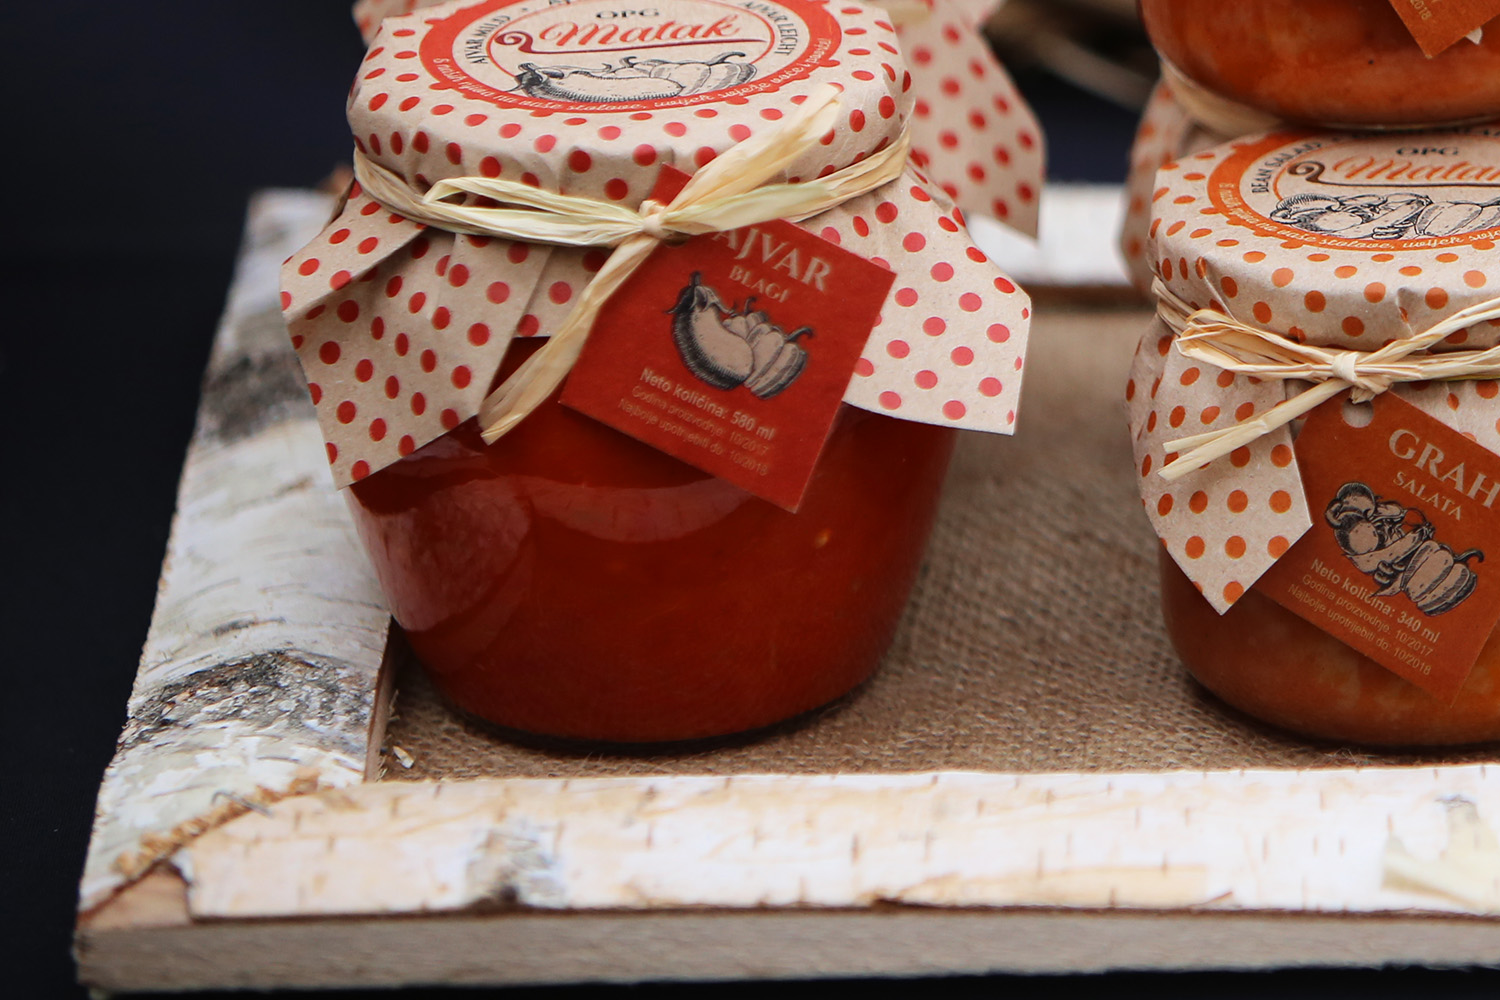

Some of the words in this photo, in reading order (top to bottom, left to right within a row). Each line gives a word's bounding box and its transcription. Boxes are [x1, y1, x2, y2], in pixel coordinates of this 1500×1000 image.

[538, 14, 742, 47] Matak
[596, 9, 660, 19] OPG
[464, 38, 489, 64] AJVAR
[774, 22, 798, 56] LEICHT
[1251, 168, 1273, 194] BEAN
[712, 225, 833, 292] AJVAR
[728, 264, 792, 304] BLAGI
[618, 398, 659, 425] Najbolje
[632, 385, 667, 410] Godina
[640, 368, 671, 392] Neto
[672, 383, 727, 419] količina:
[730, 410, 755, 432] 580
[756, 423, 776, 441] ml
[1393, 471, 1462, 521] SALATA
[1302, 574, 1335, 600] Godina
[1395, 629, 1434, 657] 10/2017
[1311, 558, 1341, 584] Neto
[1397, 611, 1421, 632] 340
[1421, 627, 1441, 643] ml
[1288, 584, 1326, 613] Najbolje
[1327, 608, 1375, 641] upotrijebiti
[1393, 649, 1432, 676] 10/2018
